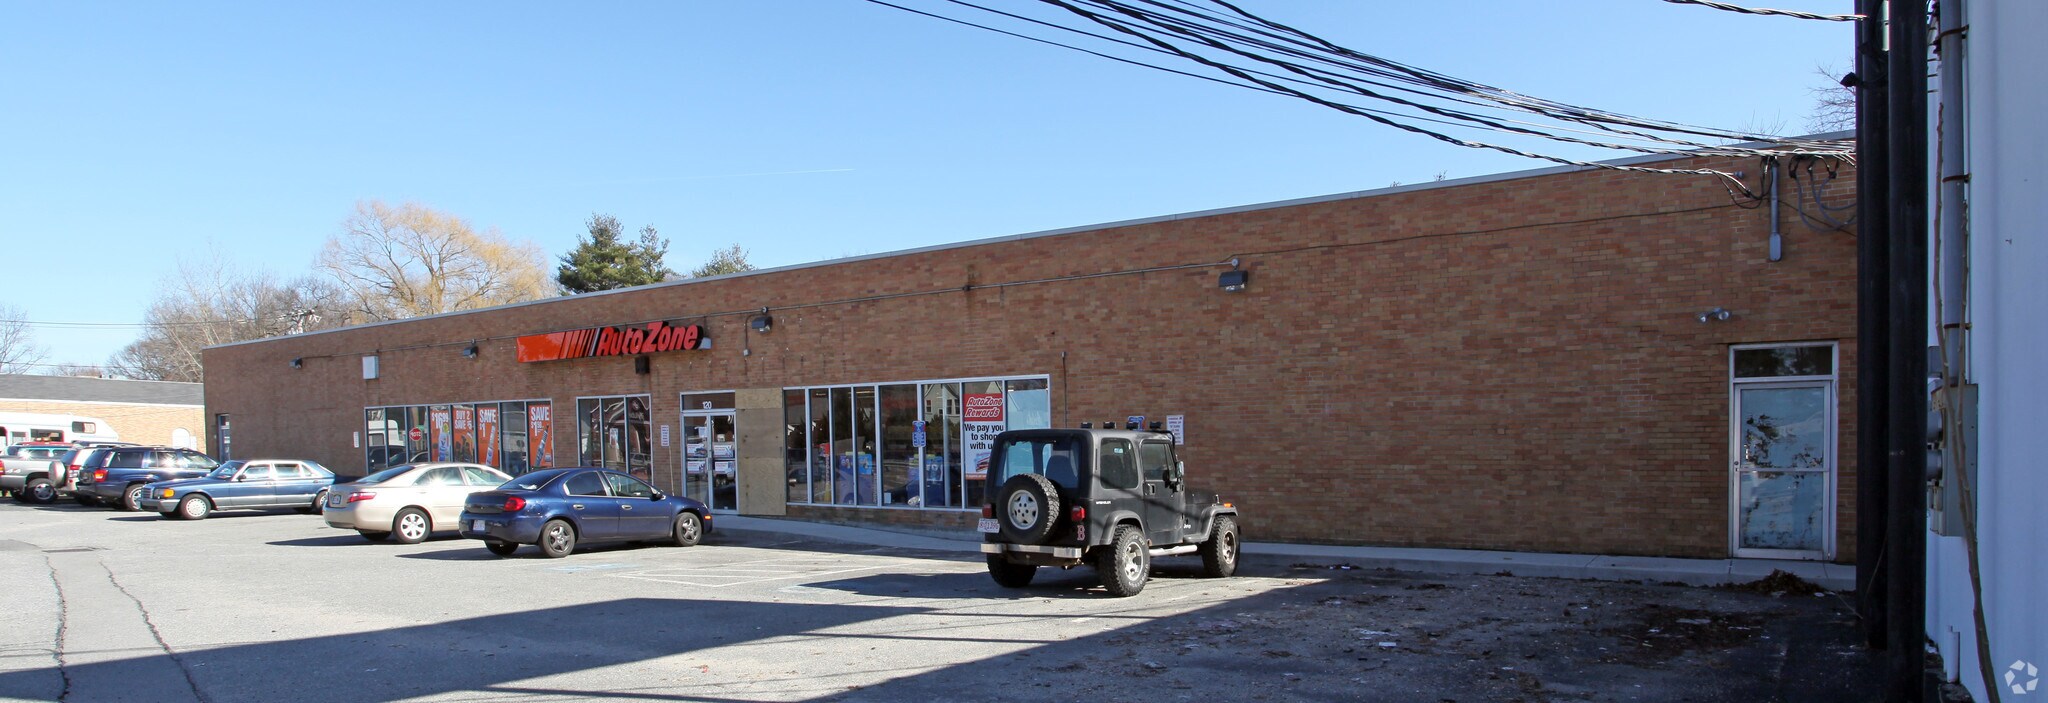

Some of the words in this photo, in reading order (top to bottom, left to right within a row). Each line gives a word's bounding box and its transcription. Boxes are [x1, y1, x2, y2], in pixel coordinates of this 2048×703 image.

[597, 321, 700, 356] AutoZone
[702, 401, 712, 410] 120
[967, 396, 1003, 406] AutoZone
[455, 410, 466, 420] BUY
[466, 410, 471, 420] 2
[479, 409, 497, 423] SAVE
[531, 406, 550, 421] SAVE
[965, 407, 1000, 417] Rewards
[454, 419, 467, 430] SAVE
[964, 423, 976, 432] We
[976, 424, 990, 433] pay
[991, 424, 1004, 433] you
[971, 433, 979, 441] to
[969, 441, 986, 450] with
